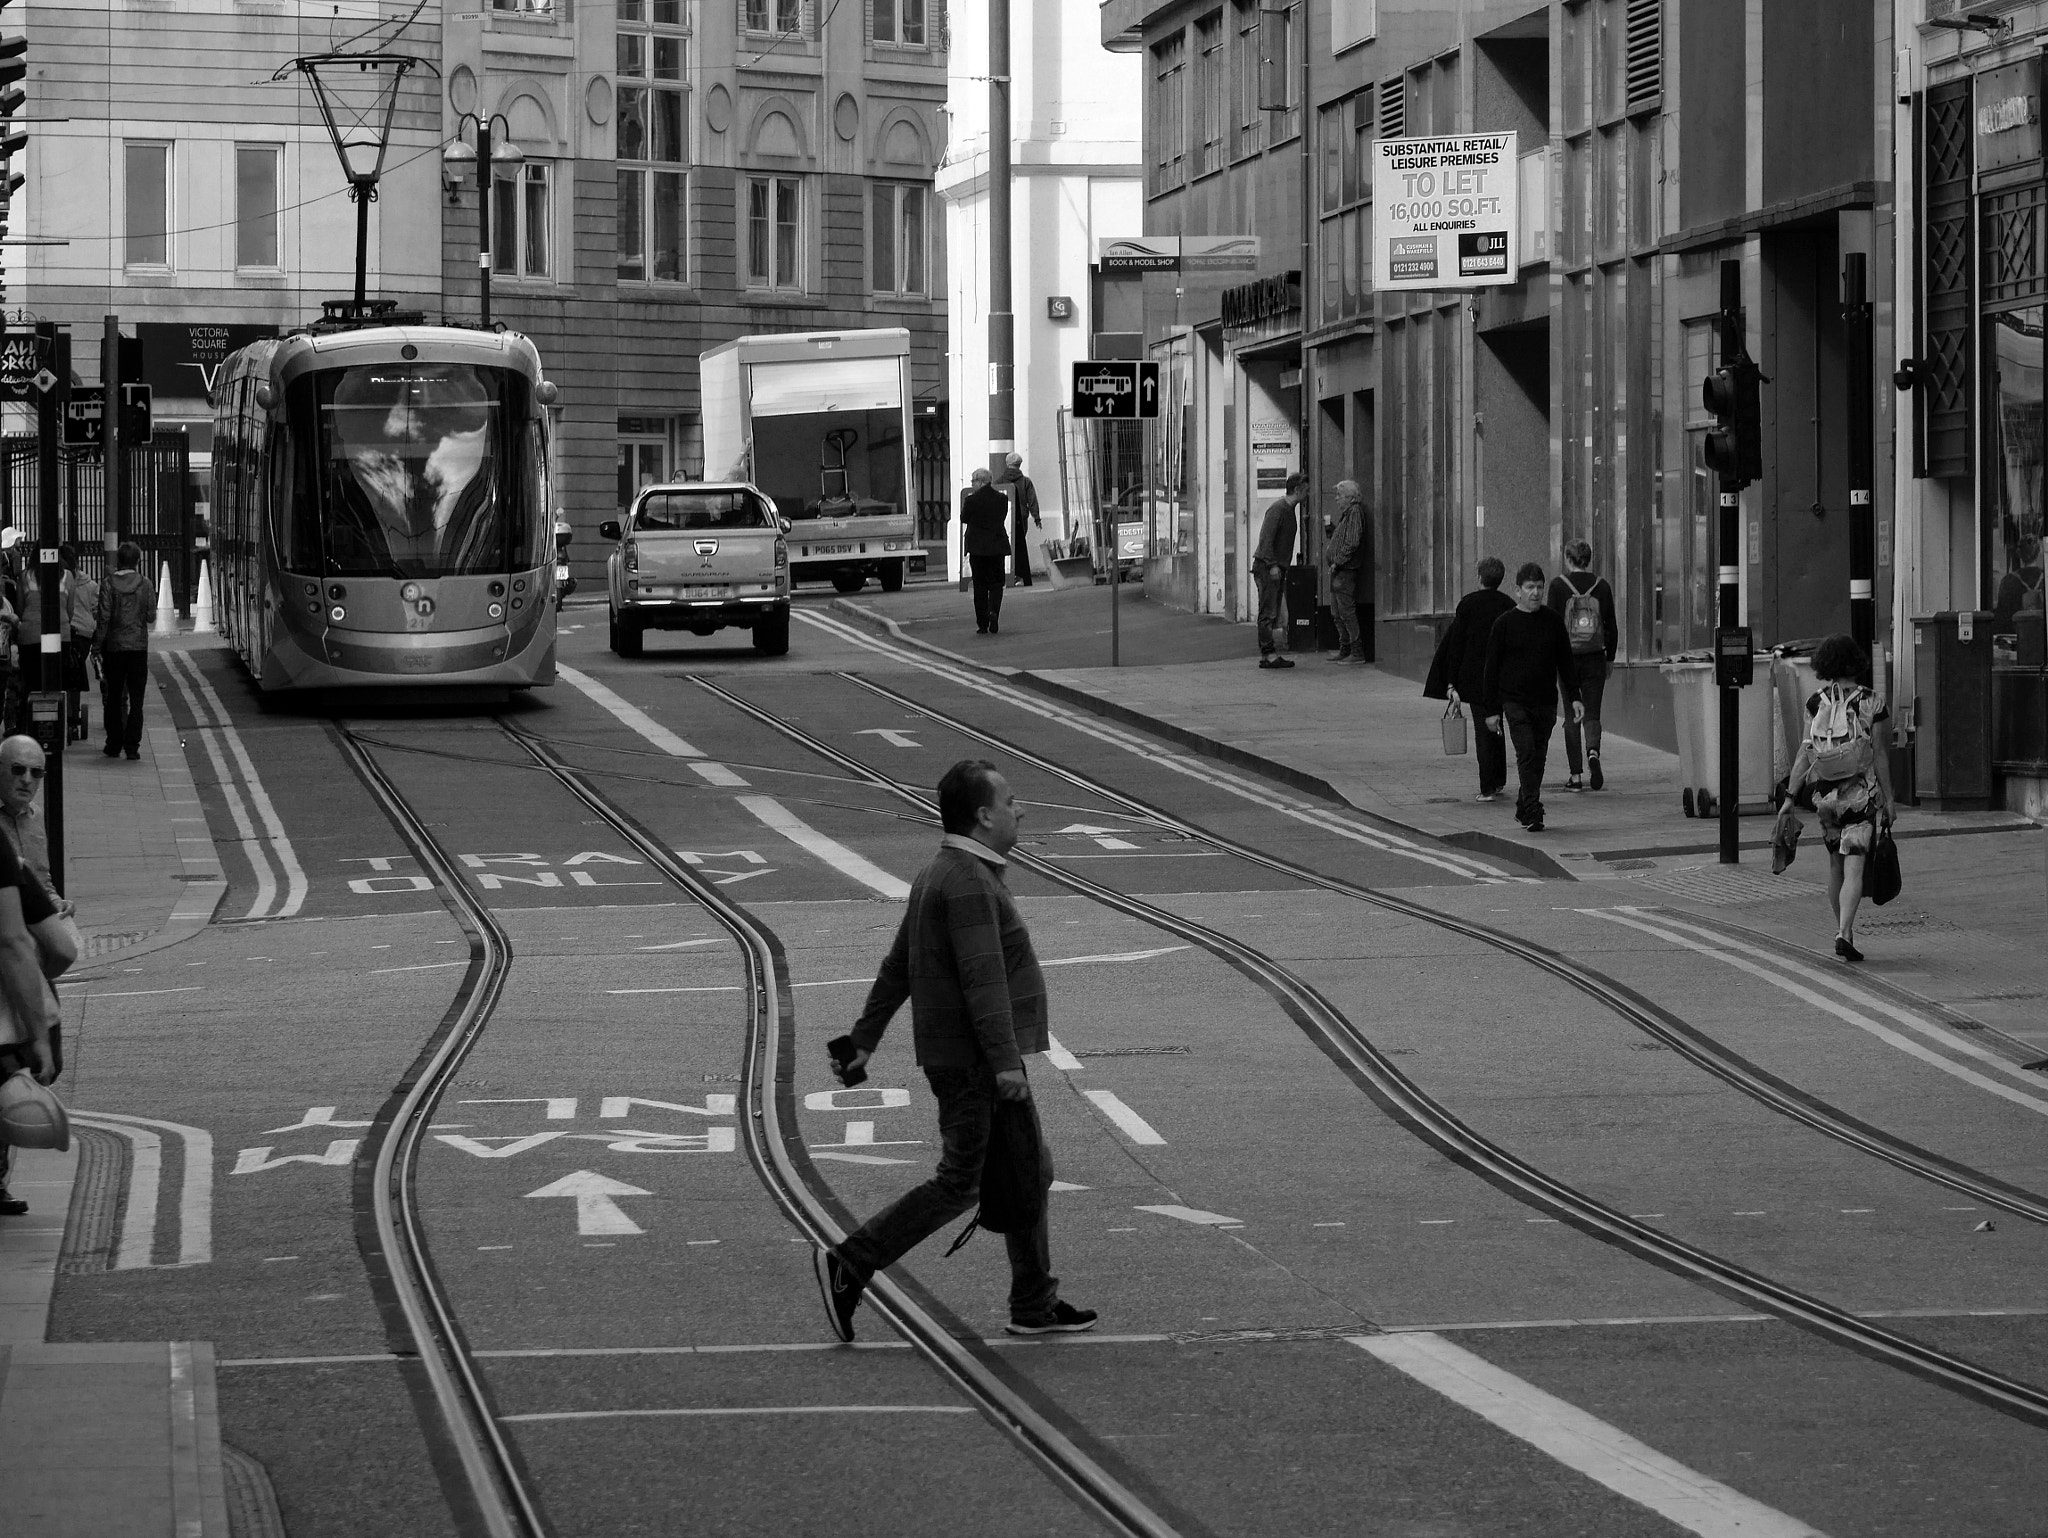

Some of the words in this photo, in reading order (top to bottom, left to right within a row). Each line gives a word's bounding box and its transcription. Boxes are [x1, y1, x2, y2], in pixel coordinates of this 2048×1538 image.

[1383, 141, 1460, 156] SUBSTANTIAL
[1463, 136, 1508, 152] RETAIL/
[1391, 156, 1437, 170] LEISURE
[1440, 152, 1499, 167] PREMISES
[1402, 171, 1436, 198] TO
[1443, 168, 1488, 196] LET
[1389, 200, 1442, 222] 16,000
[1448, 197, 1501, 216] SQ.FT.
[1413, 222, 1428, 232] ALL
[1430, 220, 1476, 231] ENQUIRIES
[1488, 237, 1506, 250] JLL
[1134, 258, 1156, 266] MODEL
[1157, 258, 1175, 266] SHOP
[1393, 263, 1408, 272] 0121
[1408, 262, 1419, 272] 232
[189, 327, 230, 338] VICTORIA
[192, 339, 227, 349] SQUARE
[192, 351, 225, 359] HOUSE
[1722, 495, 1737, 505] 13
[42, 551, 56, 561] 11
[339, 850, 768, 871] TRAM
[348, 869, 778, 894] ONLY
